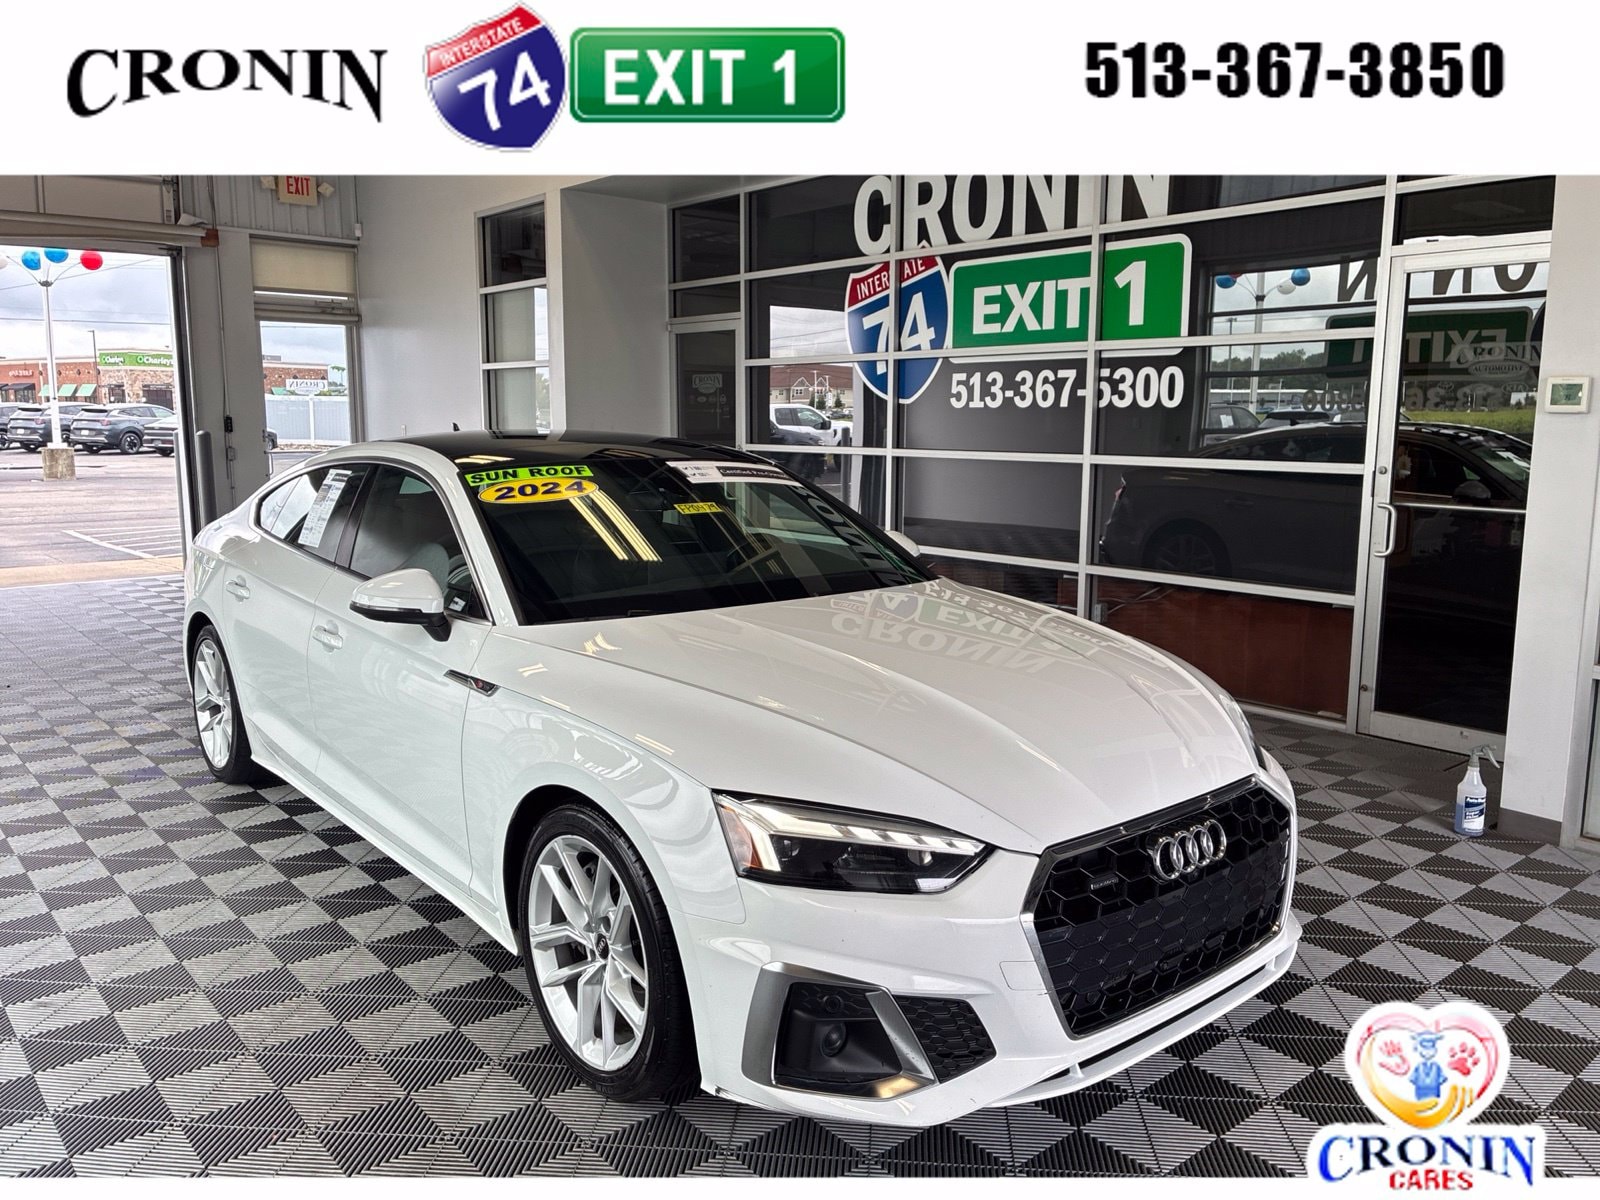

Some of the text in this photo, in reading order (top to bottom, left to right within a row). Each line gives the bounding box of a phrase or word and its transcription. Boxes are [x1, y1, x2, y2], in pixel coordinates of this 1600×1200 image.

[285, 175, 311, 197] EXIT
[853, 174, 1170, 256] CRONIN
[856, 257, 926, 300] INTERATE
[972, 260, 1147, 335] EXIT 1
[862, 291, 935, 376] 74
[950, 366, 1184, 409] 513-367-5300
[470, 466, 587, 484] SUN ROOF
[494, 480, 587, 501] 2024
